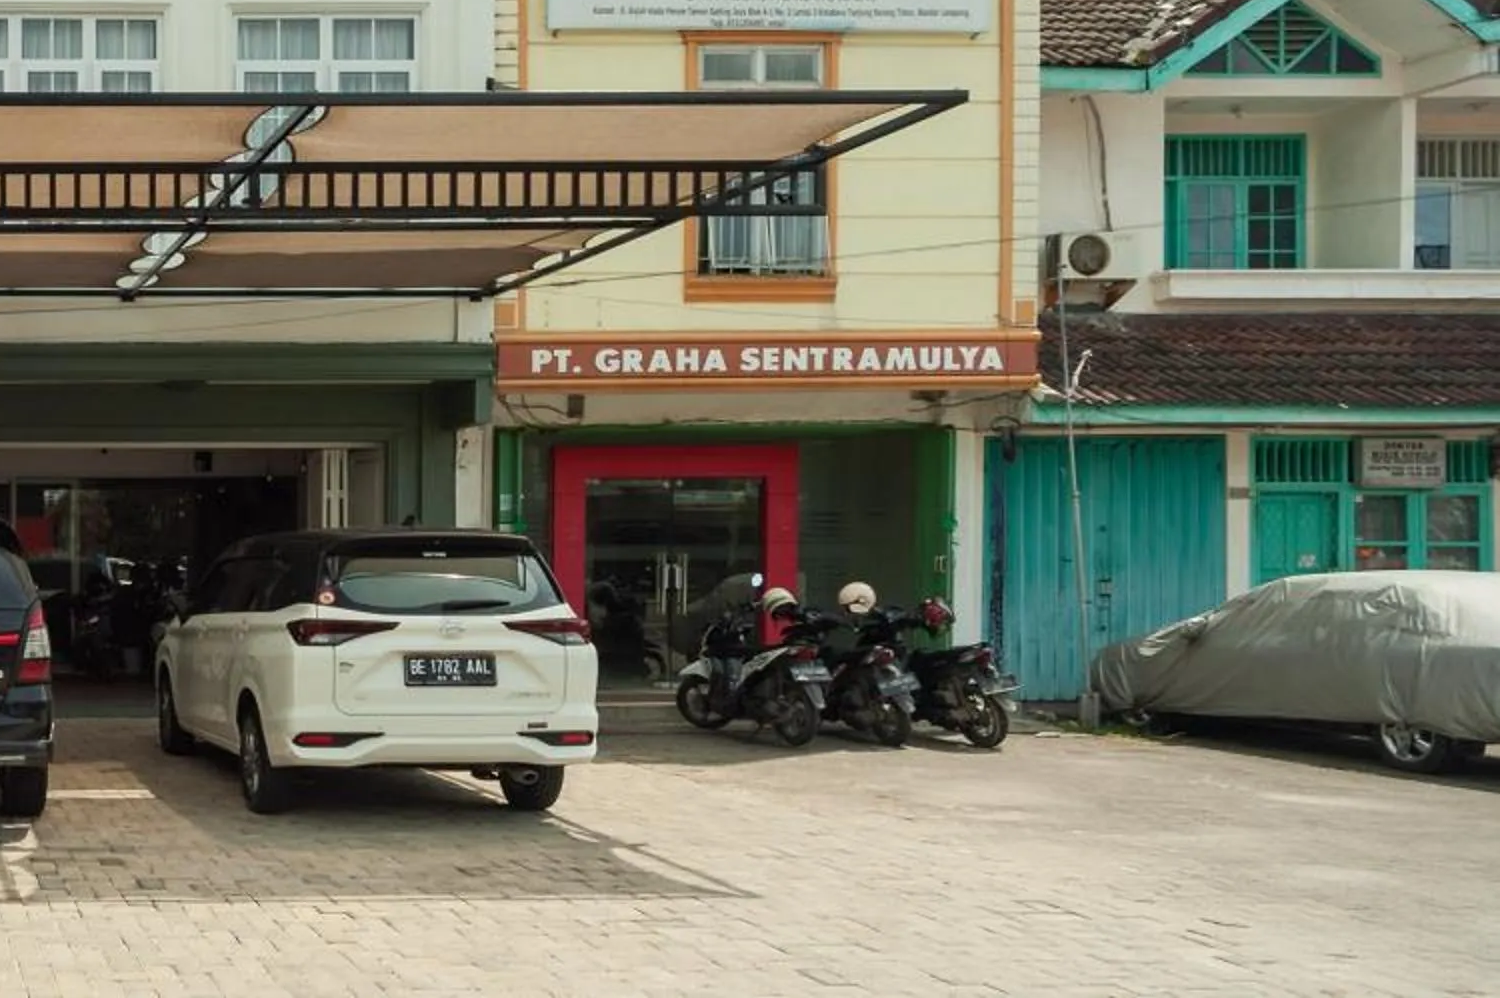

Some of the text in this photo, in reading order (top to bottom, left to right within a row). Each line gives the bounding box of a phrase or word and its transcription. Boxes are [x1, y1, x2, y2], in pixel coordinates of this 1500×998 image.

[531, 346, 1003, 373] PT. GRAHA SENTRAMULYA
[409, 659, 427, 675] BE
[466, 659, 491, 675] AAL
